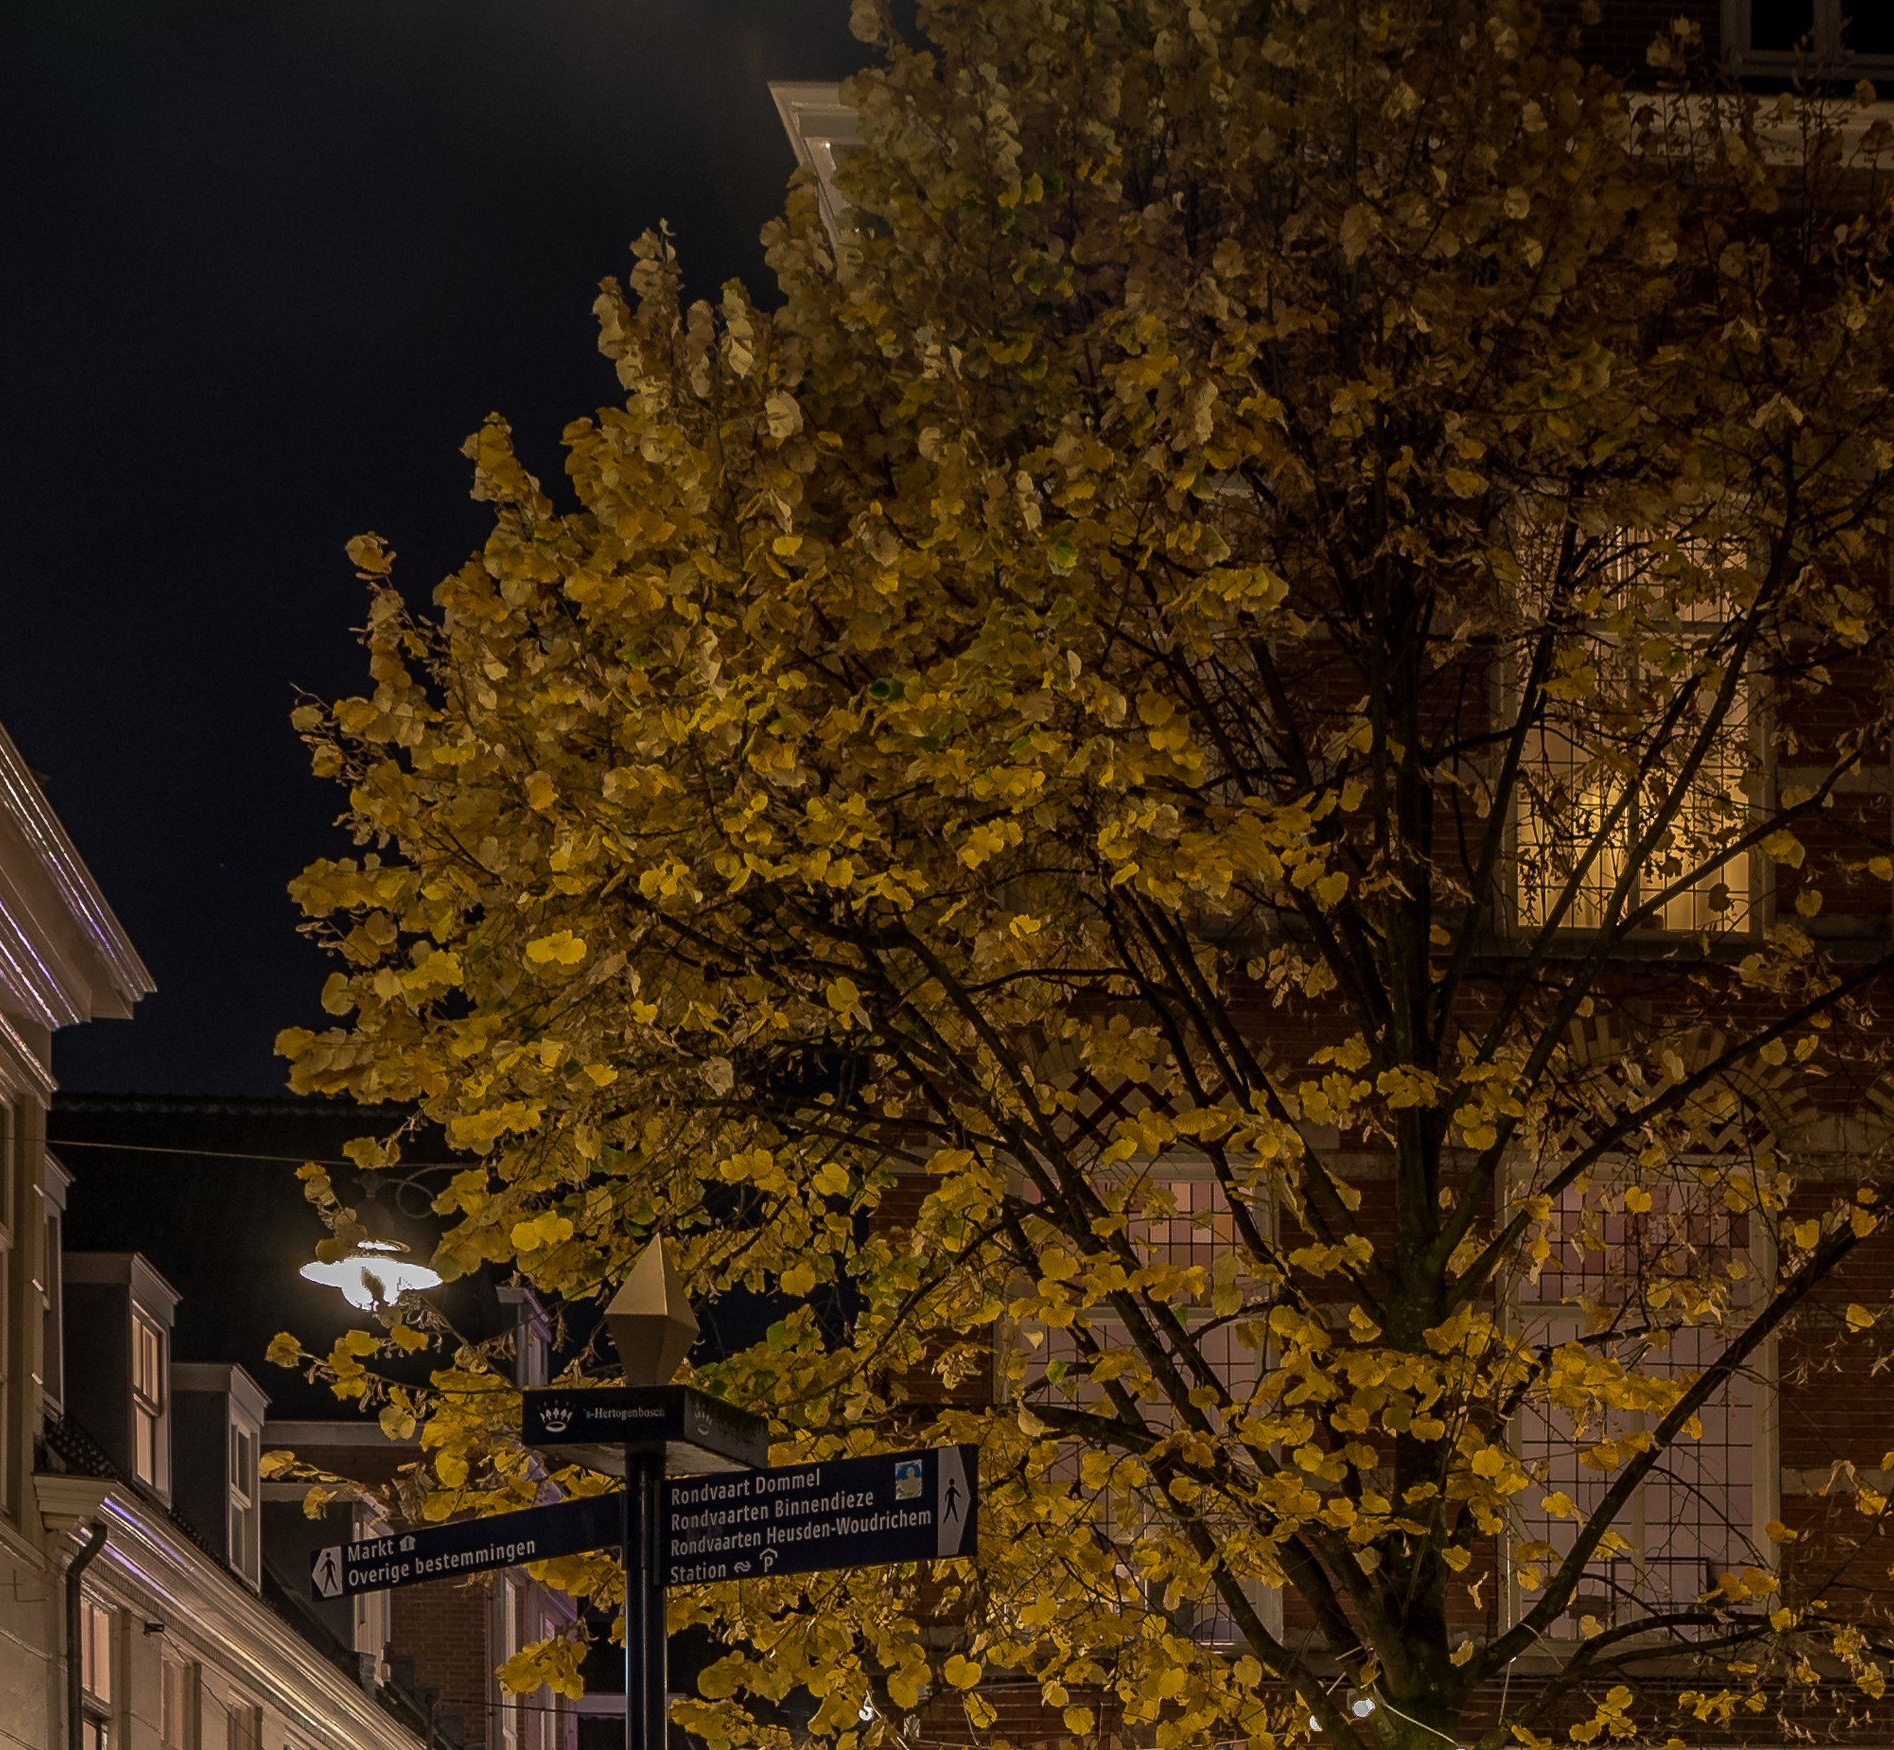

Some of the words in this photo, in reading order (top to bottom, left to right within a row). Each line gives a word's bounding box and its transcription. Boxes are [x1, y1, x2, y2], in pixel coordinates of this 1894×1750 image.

[583, 1406, 666, 1421] 's-Hertogenbosch
[671, 1478, 750, 1505] Rondvaart
[756, 1468, 821, 1495] Dommel
[671, 1503, 769, 1532] Rondvaarten
[775, 1490, 874, 1519] Binnendieze
[348, 1539, 395, 1563] Markt
[670, 1529, 762, 1557] Rondvaarten
[766, 1508, 932, 1545] Heusden-Woudrichem
[348, 1563, 410, 1586] Overige
[416, 1540, 536, 1574] bestemmingen
[670, 1562, 727, 1584] Station
